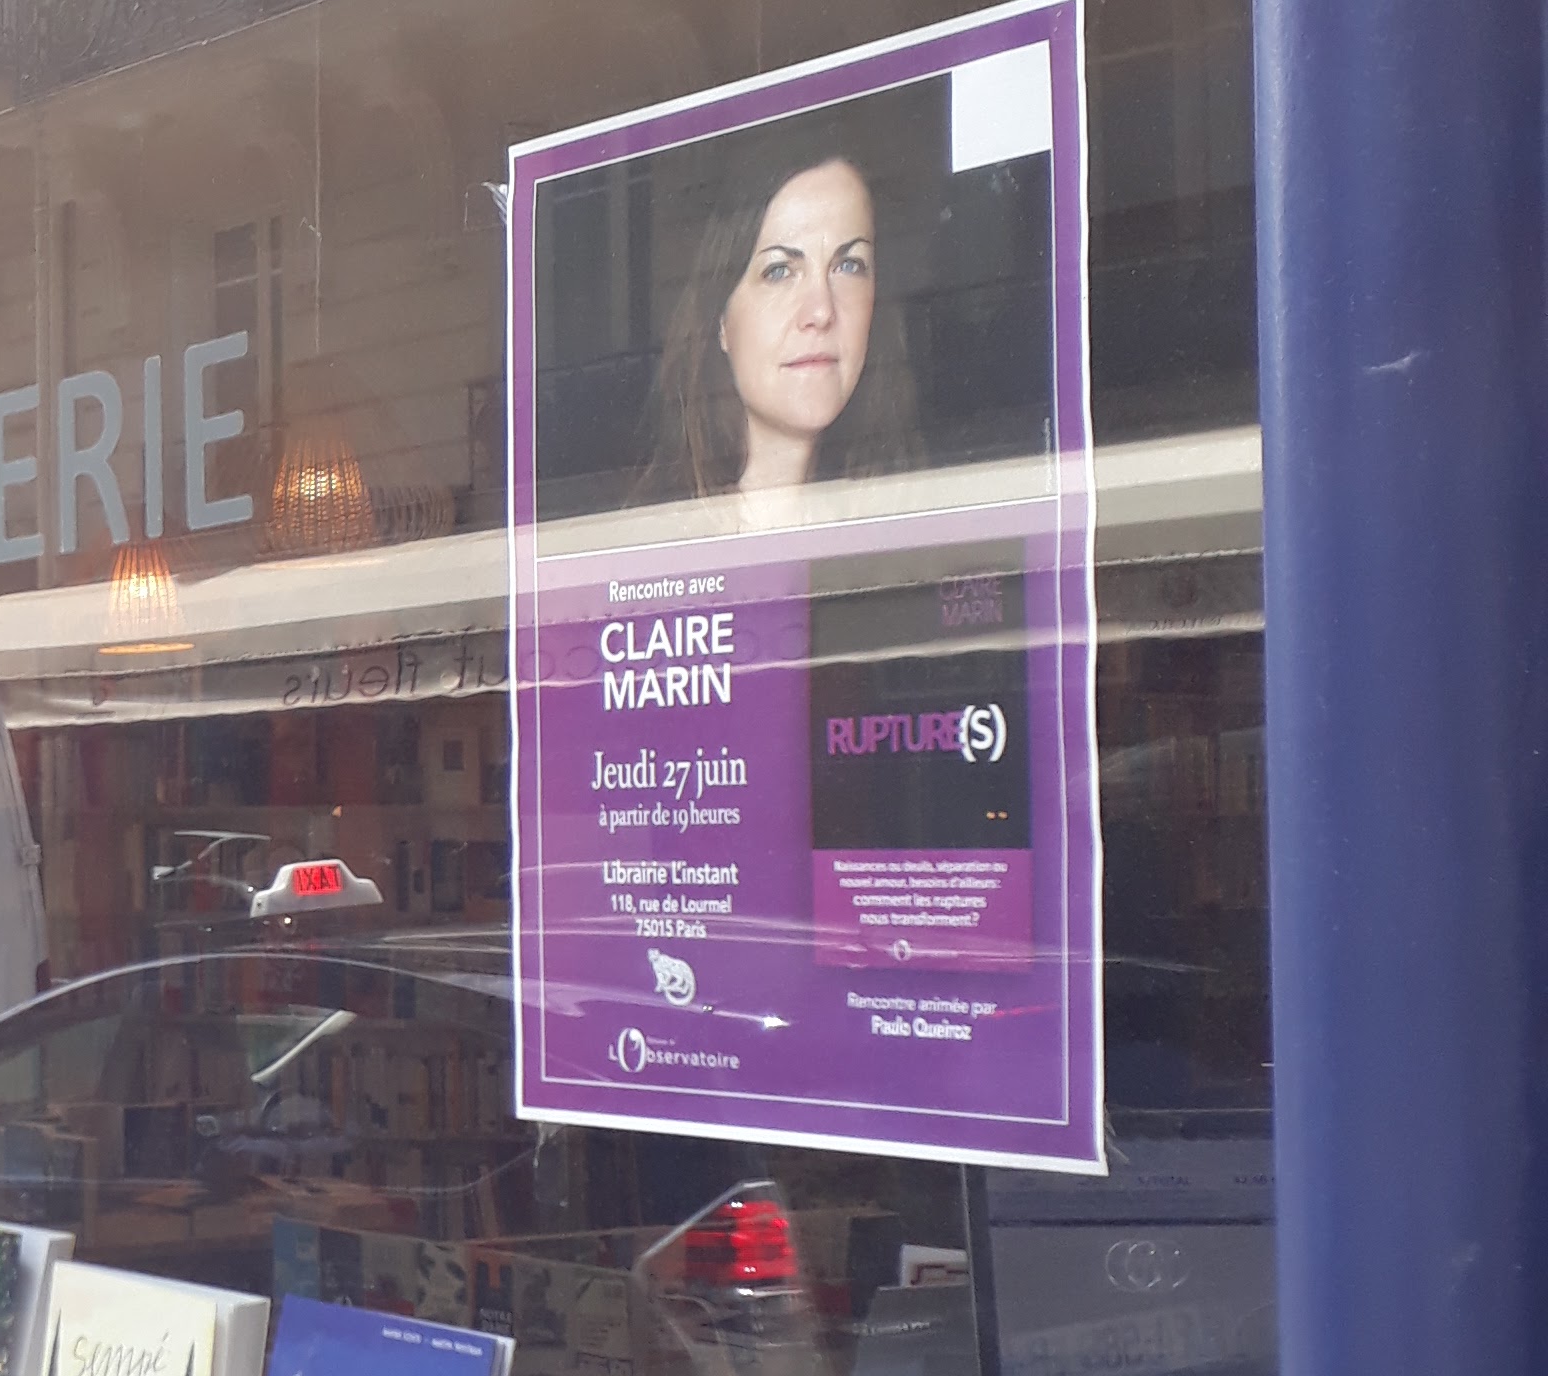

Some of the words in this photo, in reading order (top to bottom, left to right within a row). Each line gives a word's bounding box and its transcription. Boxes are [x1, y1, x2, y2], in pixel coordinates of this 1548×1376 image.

[609, 577, 684, 602] Rencontre
[689, 575, 725, 595] avec
[601, 612, 734, 663] CLAIRE
[604, 662, 732, 711] MARIN
[827, 703, 1007, 763] RUPTURE(S)
[591, 748, 657, 790] Jeudi
[662, 761, 691, 800] 27
[696, 747, 748, 800] juin
[599, 803, 608, 826] à
[609, 803, 650, 834] partir
[652, 801, 670, 825] de
[673, 808, 689, 833] 19
[688, 800, 740, 825] heures
[603, 859, 668, 885] Librairie
[671, 860, 739, 885] L'instant
[610, 893, 637, 913] 118,
[639, 898, 660, 913] rue
[662, 893, 679, 913] de
[681, 894, 733, 914] Lourmel
[635, 917, 673, 937] 75015
[676, 920, 707, 939] Paris
[847, 991, 917, 1011] Rencontre
[918, 996, 969, 1014] animée
[971, 1001, 998, 1020] par
[871, 1014, 912, 1037] Paulo
[912, 1016, 973, 1041] Queiroz
